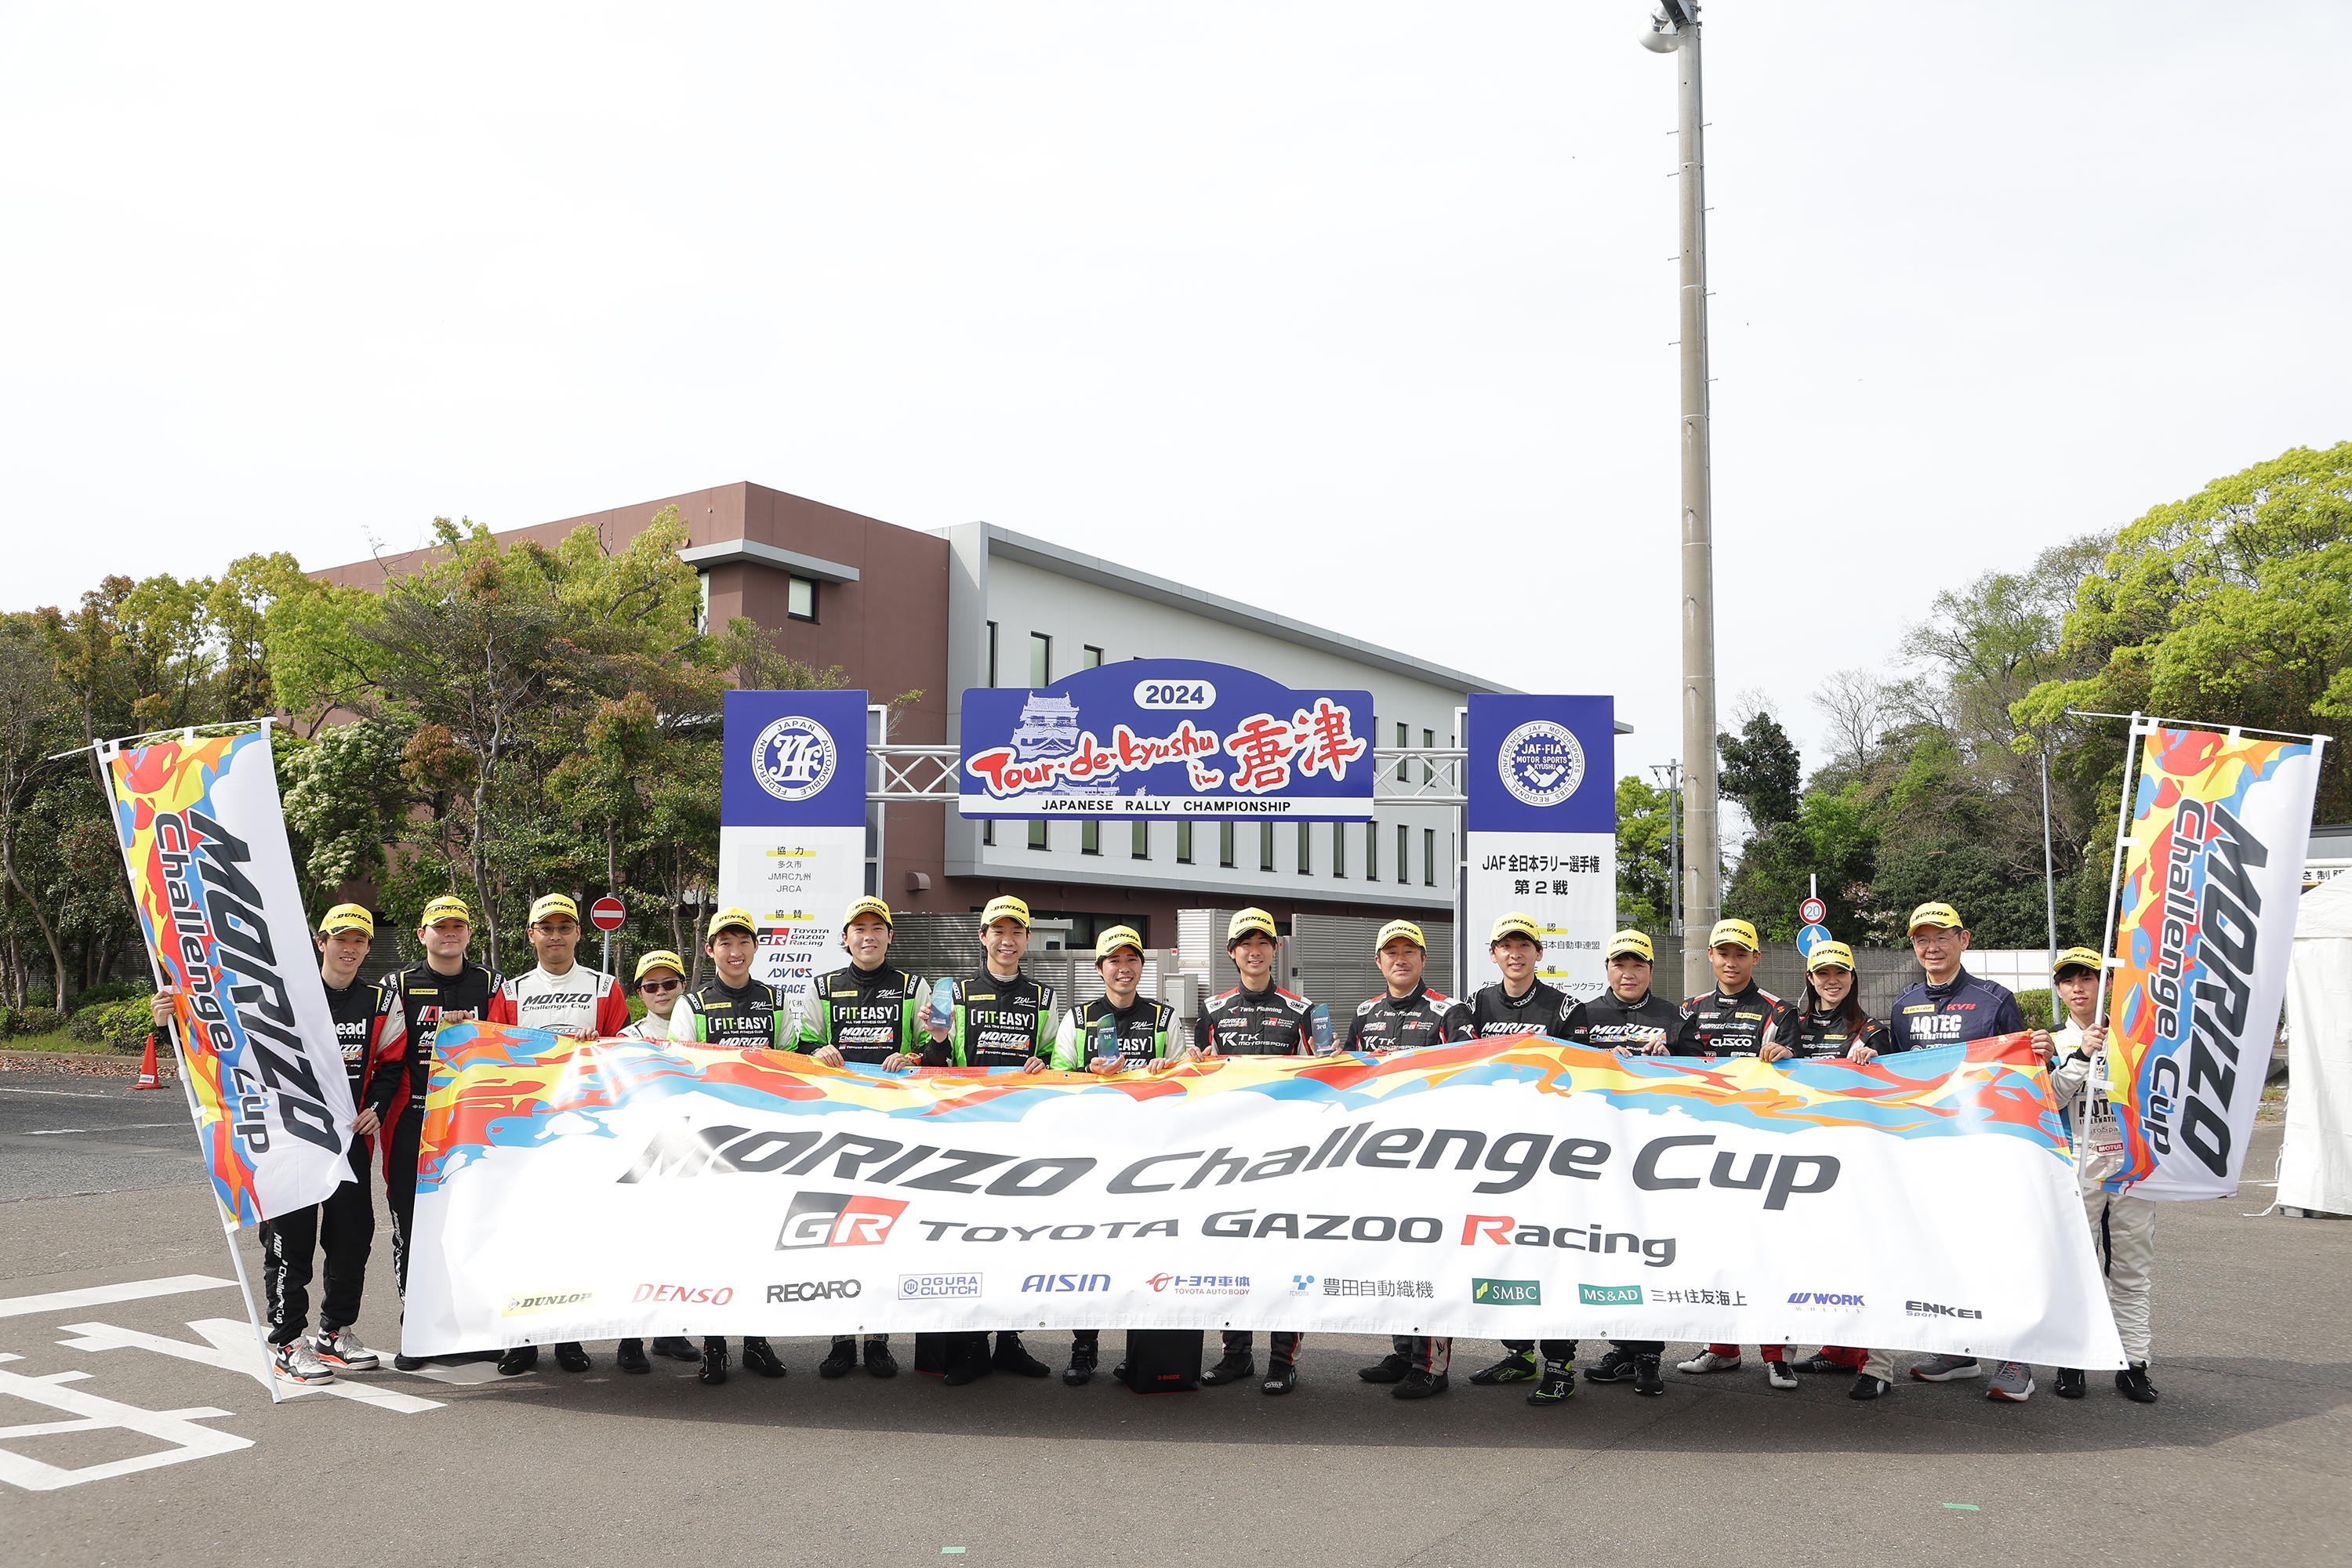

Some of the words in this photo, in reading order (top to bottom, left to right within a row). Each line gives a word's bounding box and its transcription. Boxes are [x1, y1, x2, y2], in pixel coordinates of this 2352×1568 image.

[1145, 684, 1204, 705] 2024
[777, 720, 816, 732] JAPAN
[1229, 702, 1362, 786] 唐津
[1548, 726, 1581, 774] MOTORSPORTS
[1504, 731, 1524, 779] CONFERENCE
[757, 739, 788, 797] FEDERATION
[800, 739, 833, 797] AUTOMOBILE
[1512, 782, 1550, 803] REGIONAL
[1555, 779, 1577, 800] CLUBS
[1042, 799, 1114, 811] JAPANESE
[1125, 800, 1171, 812] RALLY
[1183, 800, 1291, 813] CHAMPIONSHIP
[777, 861, 803, 869] 多久市
[768, 873, 811, 881] JMRC九州
[434, 906, 466, 915] DUNLOP
[541, 902, 574, 910] DUNLOP
[854, 902, 887, 913] DUNLOP
[994, 906, 1026, 914] DUNLOP
[1806, 906, 1820, 917] 20
[336, 913, 372, 924] DUNLOP
[719, 914, 750, 923] DUNLOP
[1240, 916, 1272, 925] DUNLOP
[1915, 911, 1950, 920] DUNLOP
[2149, 798, 2208, 1040] Challenge
[1501, 919, 1534, 929] DUNLOP
[1108, 933, 1139, 942] DUNLOP
[1386, 927, 1419, 936] DUNLOP
[1719, 928, 1752, 939] DUNLOP
[757, 933, 788, 946] GR
[1616, 938, 1650, 948] DUNLOP
[768, 953, 812, 963] AISIN
[1815, 949, 1849, 958] DUNLOP
[768, 967, 813, 978] ADVICS
[154, 812, 234, 1052] Challenge
[231, 1067, 269, 1153] Cup
[189, 808, 342, 1155] MORIZO
[2181, 801, 2268, 1177] MORIZO
[522, 993, 593, 1006] MORIZO
[1290, 1001, 1304, 1010] OMP
[336, 1018, 366, 1036] ead
[1481, 1022, 1547, 1034] MORIZO
[1589, 1022, 1664, 1035] MORIZO
[1910, 1014, 1962, 1033] AQTEC
[839, 1027, 893, 1036] MORIZO
[978, 1031, 1030, 1043] MORIZO
[1378, 1037, 1397, 1046] TK
[2143, 1055, 2180, 1156] Cup
[2099, 1144, 2123, 1152] MOTUL
[617, 1116, 1097, 1198] MORIZO
[1107, 1120, 1610, 1195] Challenge
[1632, 1134, 1842, 1211] Cup
[919, 1219, 1180, 1243] TOYOTA
[1201, 1208, 1443, 1243] GAZOO
[1461, 1214, 1675, 1268] Racing
[920, 1276, 978, 1287] OGURA
[1021, 1274, 1112, 1293] AISIN
[1174, 1276, 1250, 1287] トヨタ車体
[1323, 1277, 1435, 1299] 豊田自動織機
[631, 1283, 734, 1306] DENSO
[767, 1279, 862, 1304] RECARO
[920, 1286, 978, 1296] CLUTCH
[1492, 1285, 1538, 1301] SMBC
[1584, 1288, 1639, 1301] MS&AD
[521, 1293, 593, 1308] DUNLOP
[1651, 1289, 1748, 1307] 三井住友海上
[1813, 1293, 1866, 1307] WORK
[1905, 1301, 1983, 1319] ENKEI
